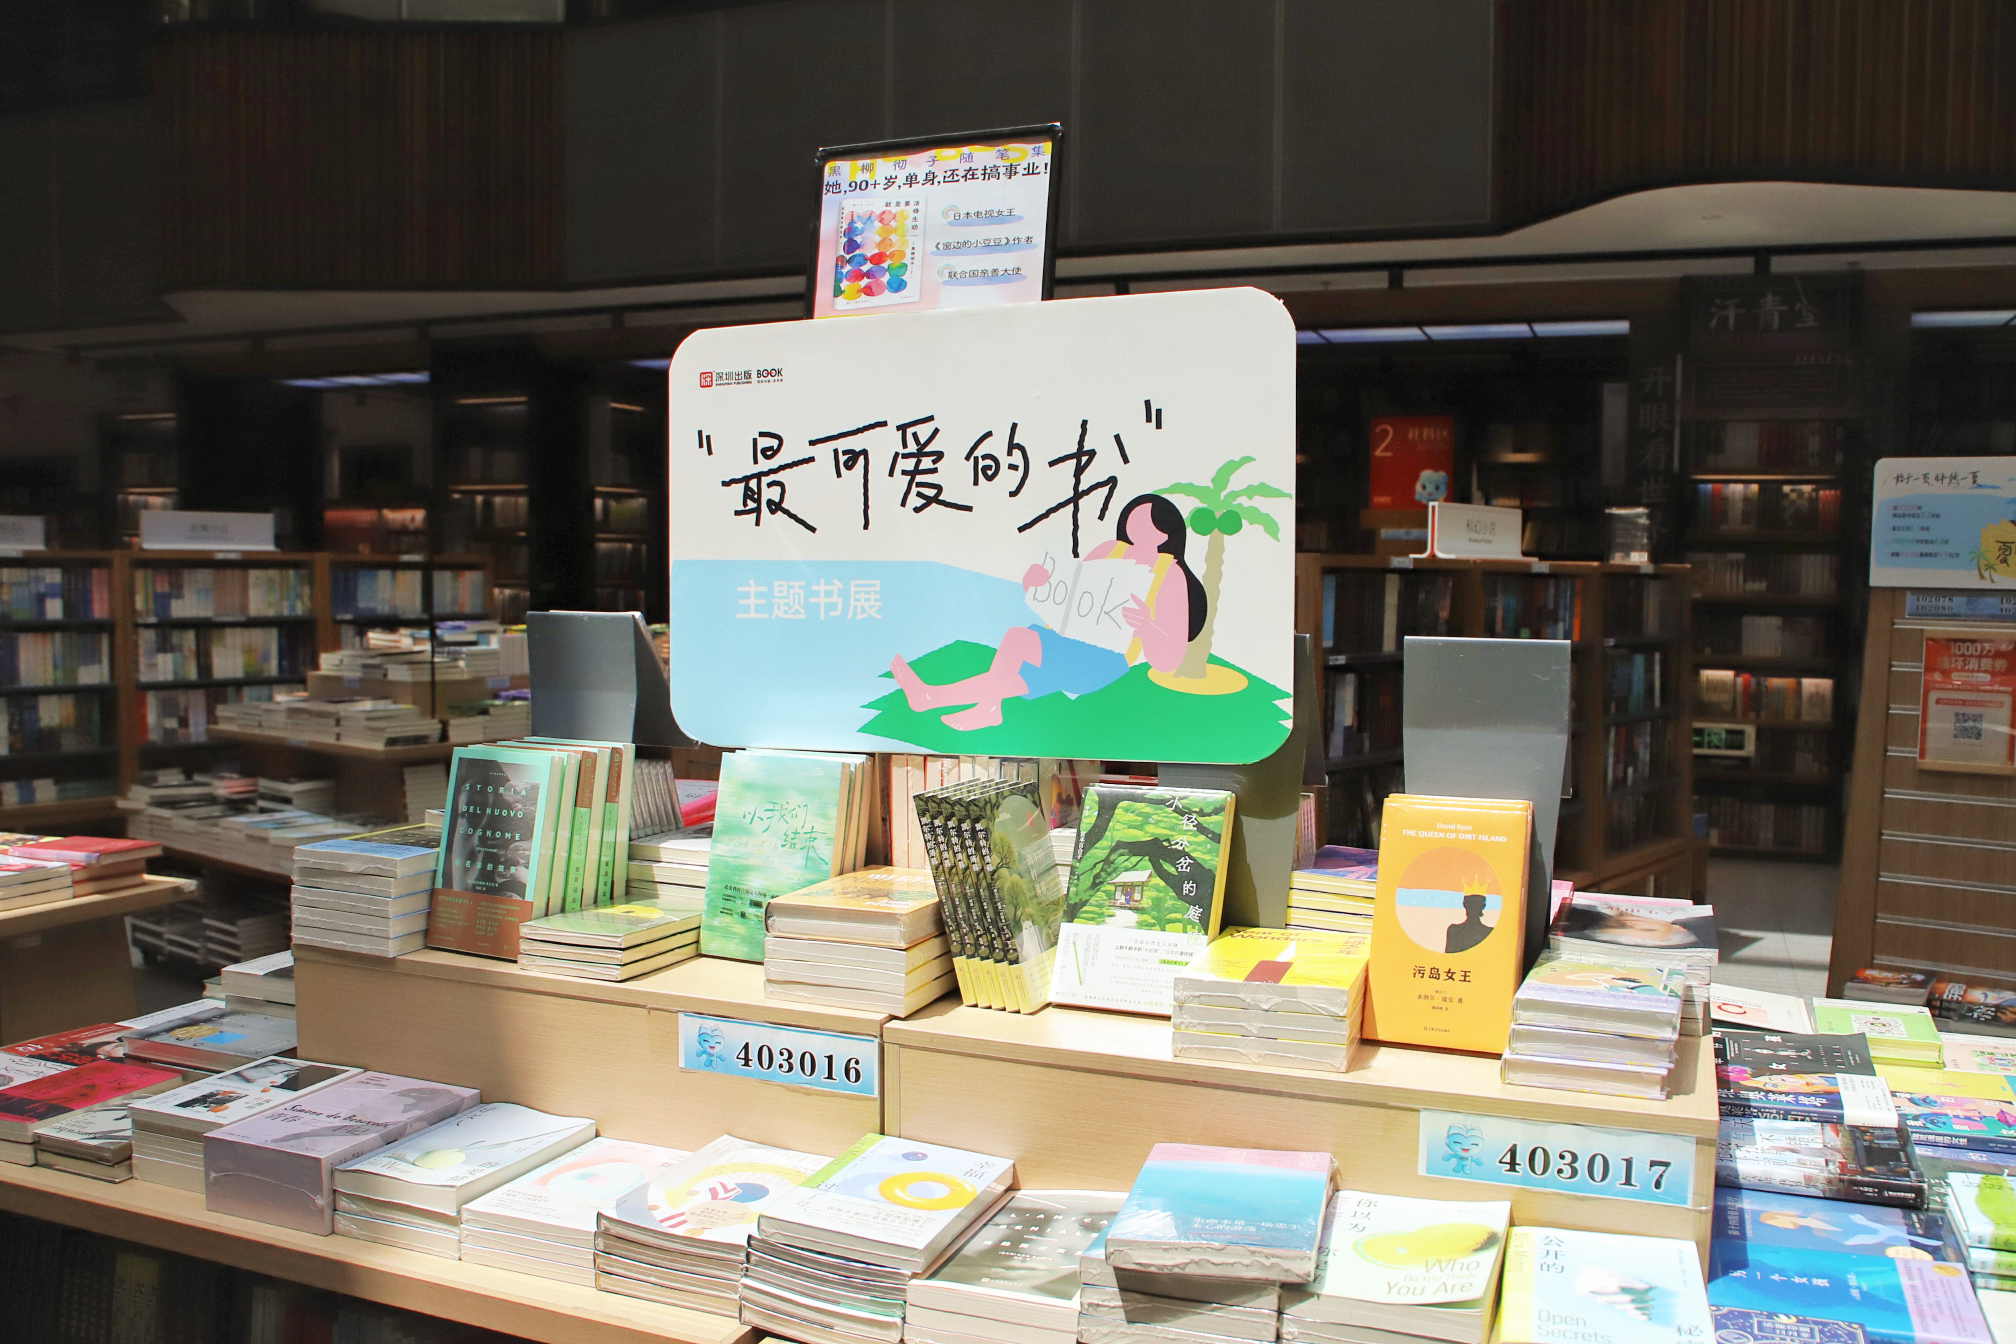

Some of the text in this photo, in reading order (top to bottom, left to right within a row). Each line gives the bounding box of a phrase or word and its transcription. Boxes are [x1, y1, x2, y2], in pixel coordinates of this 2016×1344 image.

[828, 145, 1046, 178] 黑柳彻子随笔集
[953, 208, 1016, 220] 日本电视女王
[934, 236, 1034, 251] 《窗边的小豆豆》作者
[947, 266, 1022, 279] 联合国亲善大使
[716, 370, 752, 382] 深圳出版
[757, 368, 783, 378] BOOK
[1375, 425, 1393, 456] 2
[735, 578, 884, 620] 主题书展
[1951, 642, 1996, 656] 1000万
[465, 783, 527, 796] STORIA
[462, 805, 524, 819] DEL NUOVO
[459, 827, 521, 841] COGNOME
[1437, 822, 1473, 832] Donal Ryan
[1402, 829, 1417, 837] THE
[1418, 830, 1445, 839] QUEEN
[1459, 833, 1477, 841] DIRT
[1478, 834, 1507, 843] ISLAND
[780, 825, 829, 869] 结束
[1166, 796, 1204, 946] 小径分岔的庭院
[1229, 933, 1323, 943] Wonders
[1280, 930, 1304, 938] of
[1412, 965, 1472, 983] 污岛女王
[736, 1042, 862, 1083] 403016
[284, 1105, 323, 1116] Simone
[1498, 1143, 1672, 1190] 403017
[1344, 1198, 1378, 1233] 你以为
[1540, 1235, 1566, 1274] 公开的
[1425, 1259, 1480, 1273] Who
[1404, 1272, 1476, 1283] Do You Think
[1386, 1280, 1473, 1296] You Are
[1537, 1308, 1588, 1328] Open
[1537, 1325, 1613, 1344] Secrets
